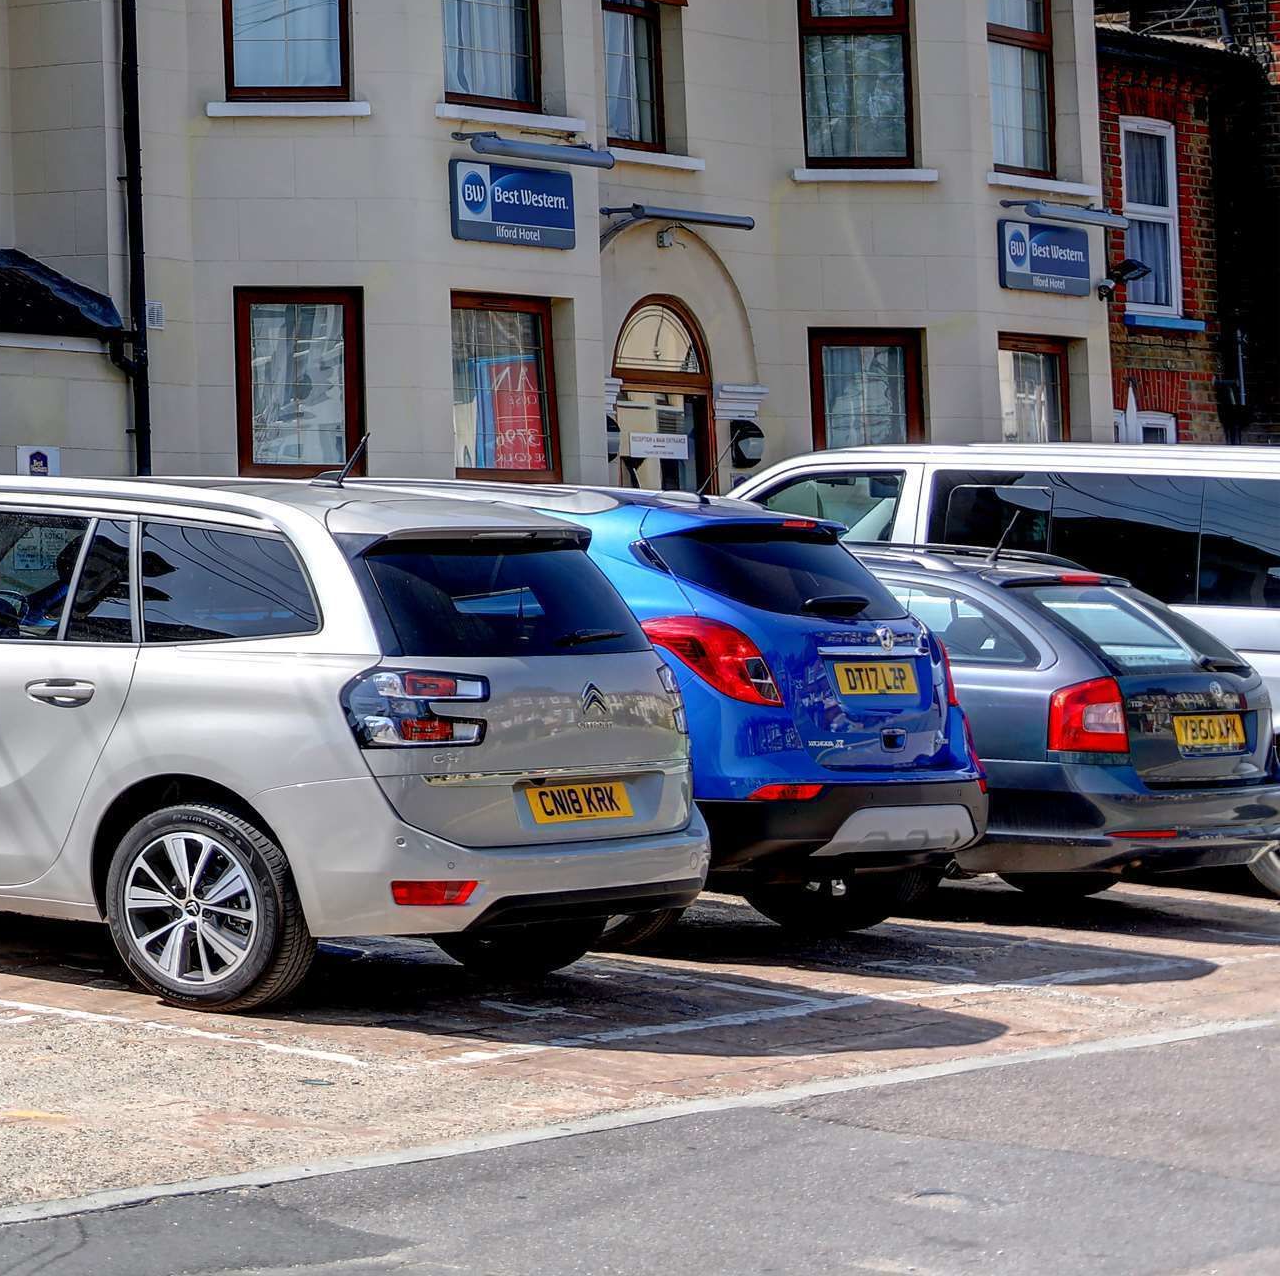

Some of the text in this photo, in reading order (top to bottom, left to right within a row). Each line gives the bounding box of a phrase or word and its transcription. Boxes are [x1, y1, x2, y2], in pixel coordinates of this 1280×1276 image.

[465, 184, 484, 202] BW
[495, 187, 519, 204] Best
[496, 226, 540, 241] Ilford Hotel
[1010, 241, 1025, 256] BW
[1032, 243, 1050, 258] Best
[844, 667, 878, 690] DT17
[538, 786, 621, 816] CN18 KRK
